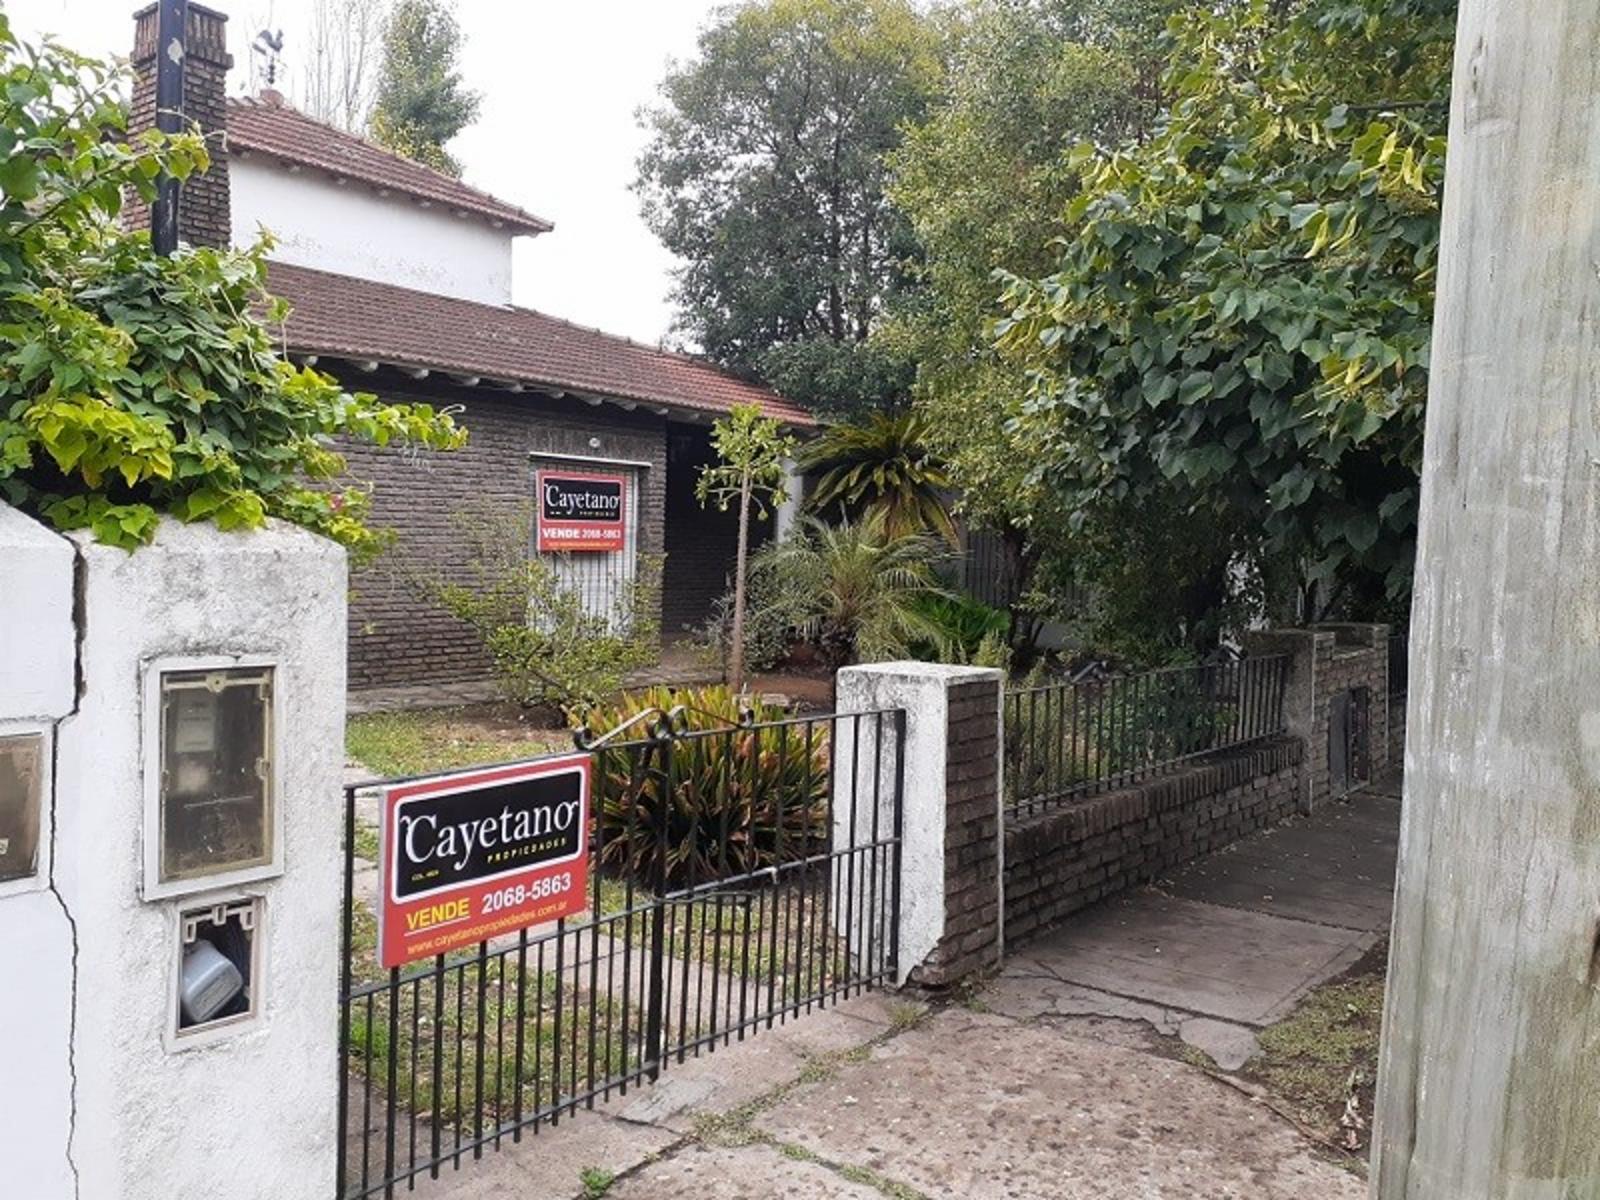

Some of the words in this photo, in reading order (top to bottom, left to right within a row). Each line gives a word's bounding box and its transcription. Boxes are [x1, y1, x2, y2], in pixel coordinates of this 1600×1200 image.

[544, 484, 620, 515] Cayetano
[542, 527, 580, 538] VENDE
[400, 801, 579, 871] Cayetano
[486, 838, 567, 864] PROPIEDADES
[406, 898, 470, 930] VENDE
[481, 872, 571, 914] 2068-5863
